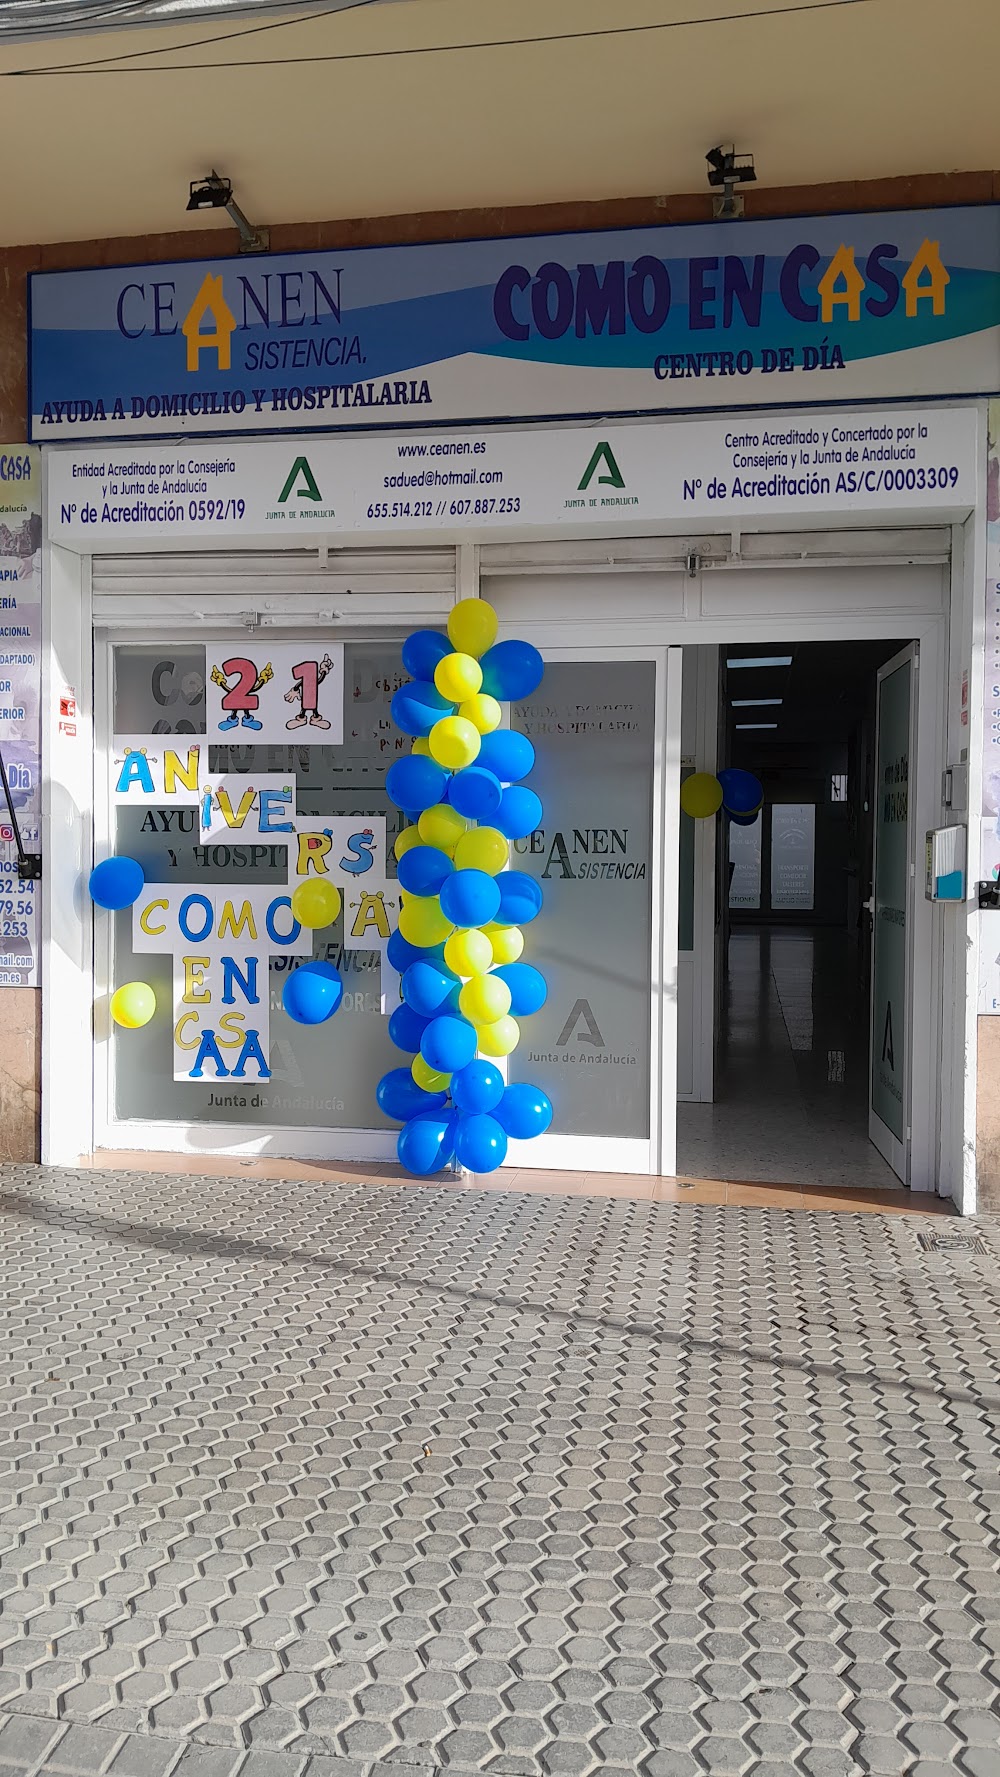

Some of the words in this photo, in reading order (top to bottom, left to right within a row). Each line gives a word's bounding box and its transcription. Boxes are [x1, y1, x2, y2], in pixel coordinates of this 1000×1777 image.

[493, 255, 670, 341] COMO
[688, 254, 765, 331] EN
[780, 237, 950, 323] CASA
[654, 349, 753, 380] CENTRO
[761, 347, 794, 373] DE
[802, 336, 845, 371] DÍA
[41, 398, 106, 425] AYUDA
[111, 400, 128, 420] A
[131, 390, 246, 419] DOMICILIO
[253, 389, 269, 413] Y
[271, 380, 432, 411] HOSPITALARIA
[725, 432, 759, 448] Centro
[762, 428, 819, 446] Acreditado
[822, 433, 829, 447] y
[831, 426, 894, 443] Concertado
[896, 427, 915, 443] por
[917, 423, 928, 438] la
[397, 440, 486, 458] www.ceanen.es
[733, 452, 788, 470] Consejería
[791, 455, 797, 469] y
[800, 451, 810, 465] la
[812, 450, 842, 465] Junta
[845, 447, 859, 463] de
[862, 445, 916, 462] Andalucía
[0, 454, 31, 481] CASA
[72, 462, 105, 478] Entidad
[108, 462, 157, 477] Acreditada
[159, 464, 175, 478] por
[176, 460, 186, 474] la
[188, 458, 236, 477] Consejería
[383, 468, 503, 488] sadued@hotmail.com
[102, 487, 108, 499] y
[109, 481, 118, 495] la
[120, 481, 145, 495] Junta
[148, 480, 160, 494] de
[162, 478, 207, 494] Andalucía
[707, 477, 727, 499] de
[731, 472, 830, 498] Acreditación
[835, 466, 959, 494] AS/C/0003309
[80, 502, 98, 523] de
[101, 500, 184, 522] Acreditación
[189, 498, 246, 521] 0592/19
[265, 511, 286, 520] JUNTA
[288, 510, 297, 519] DE
[366, 501, 433, 519] 655.514.212
[450, 497, 521, 516] 607.887.253
[563, 499, 586, 509] JUNTA
[589, 498, 598, 507] DE
[8, 764, 30, 789] Día
[140, 811, 200, 832] AYU
[577, 862, 646, 879] SISTENCIA
[140, 894, 301, 945] COMO
[182, 957, 260, 1004] EN
[528, 1052, 558, 1062] Junta
[562, 1053, 576, 1063] de
[579, 1053, 636, 1065] Andalucía
[208, 1094, 247, 1107] Junta
